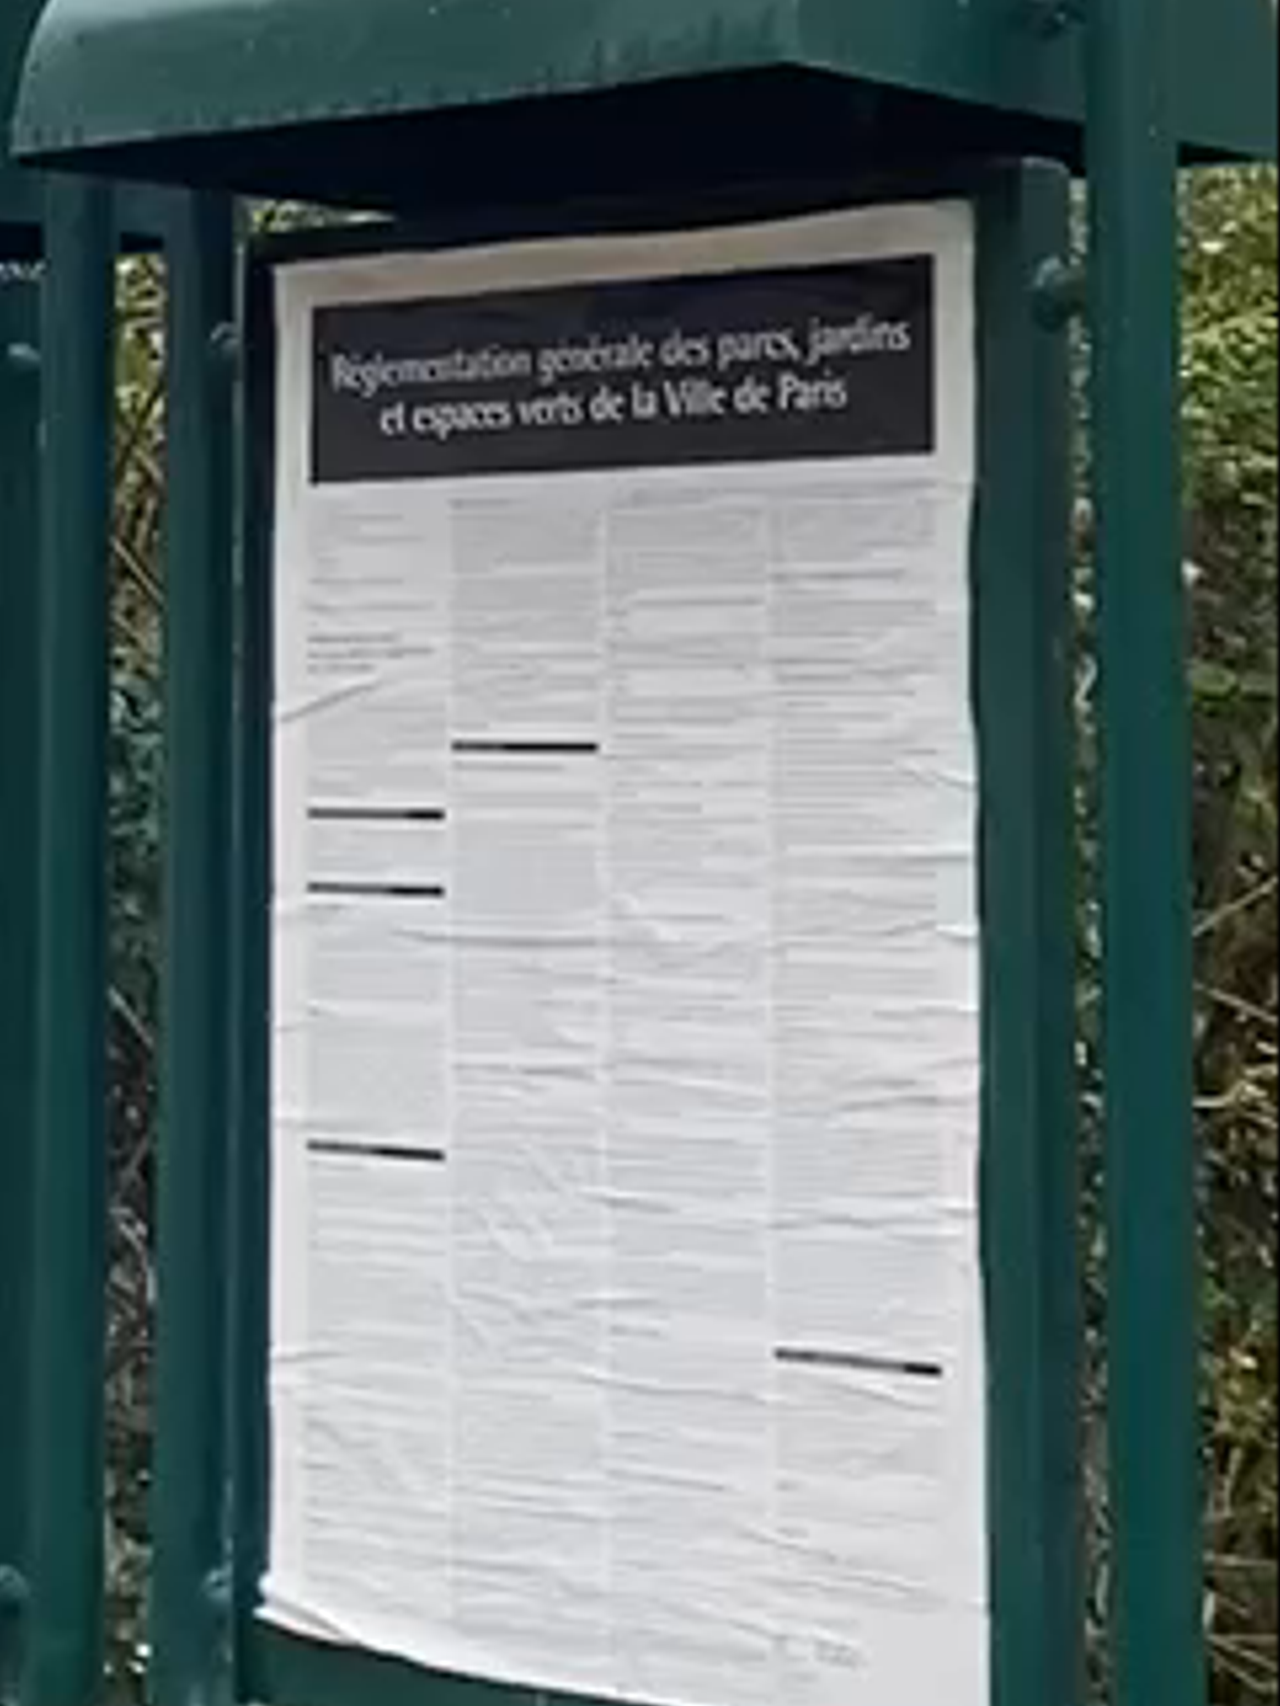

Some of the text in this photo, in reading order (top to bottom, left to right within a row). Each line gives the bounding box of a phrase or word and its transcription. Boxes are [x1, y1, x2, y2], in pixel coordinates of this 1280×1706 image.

[539, 335, 654, 384] générale
[659, 328, 709, 366] des
[806, 313, 911, 366] jardins
[380, 366, 848, 440] et espaces verts de la Ville de Paris
